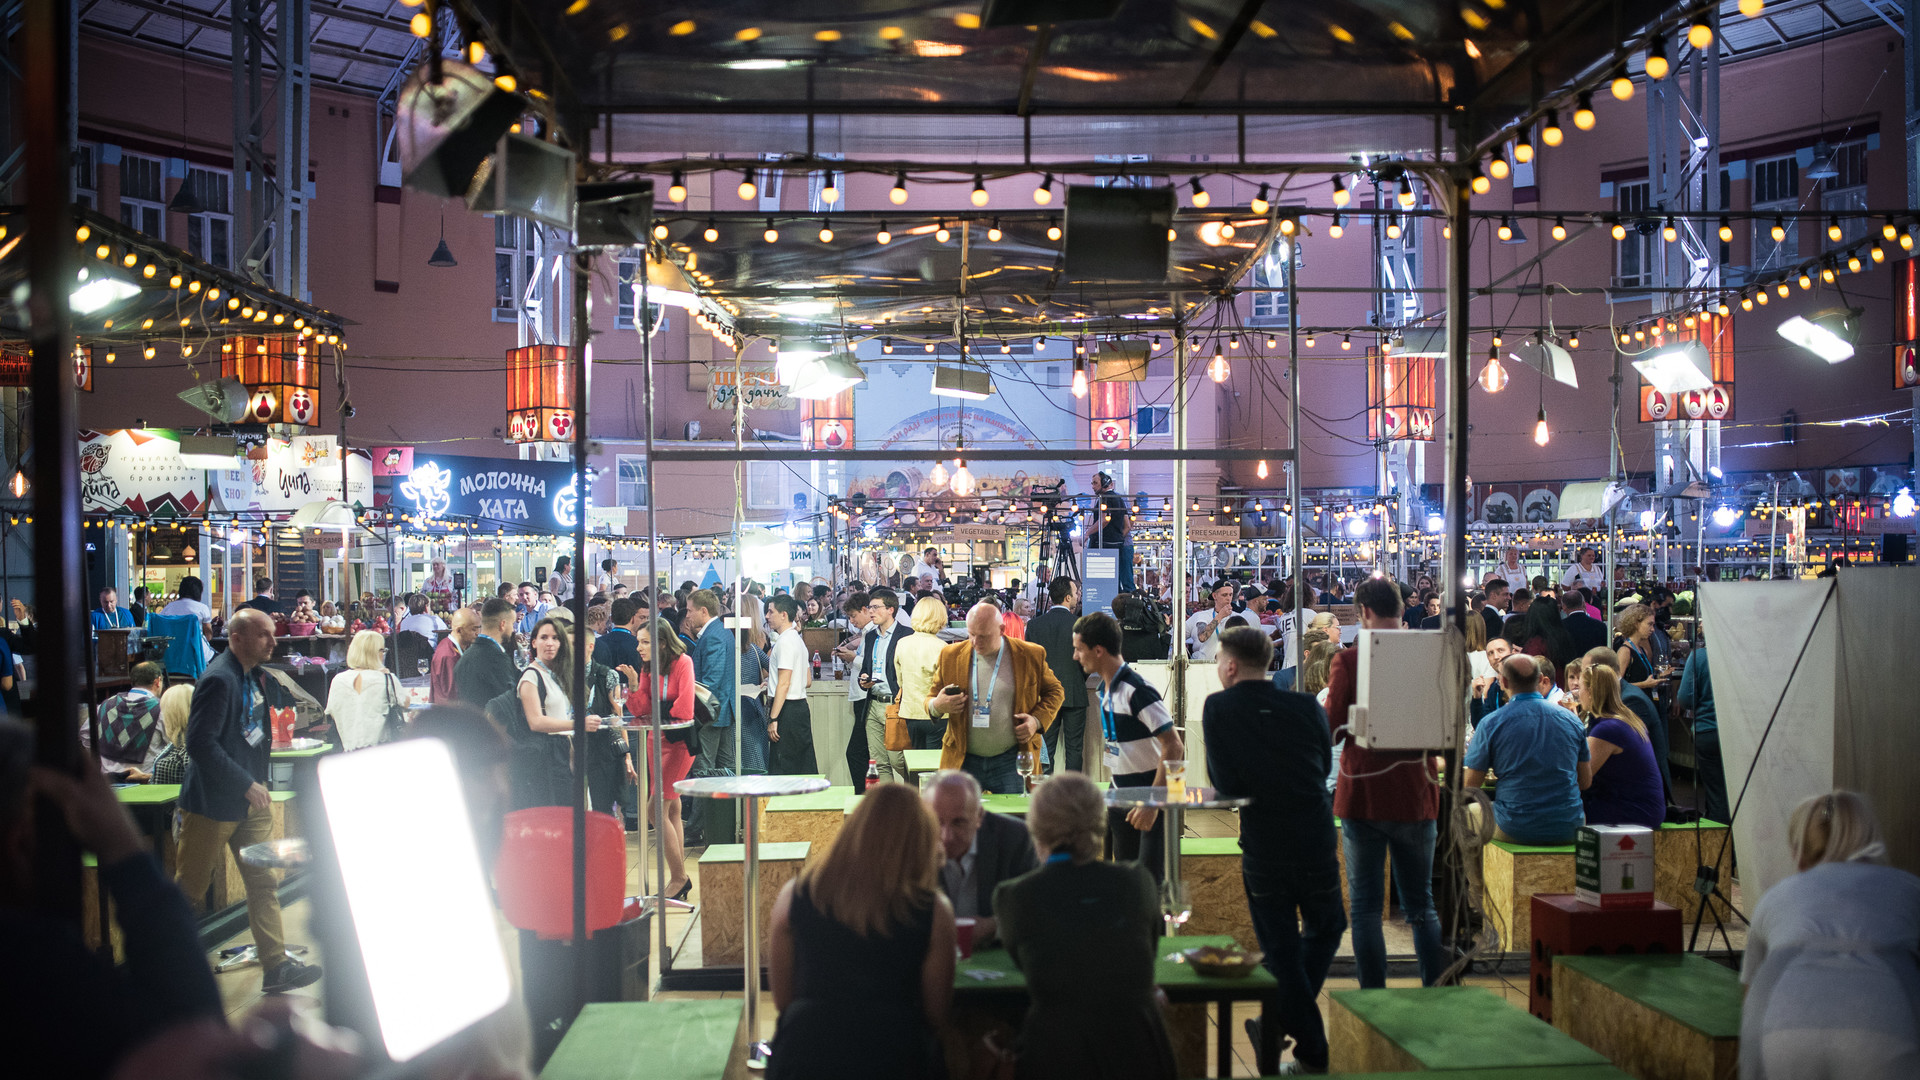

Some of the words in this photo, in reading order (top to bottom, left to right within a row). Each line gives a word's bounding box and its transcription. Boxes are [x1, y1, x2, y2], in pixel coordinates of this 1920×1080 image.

[224, 470, 246, 482] BEER
[459, 471, 546, 498] МОЛОЧНА
[224, 488, 246, 499] SHOP
[478, 498, 529, 519] ХАТА
[960, 528, 1000, 536] VEGETABLES
